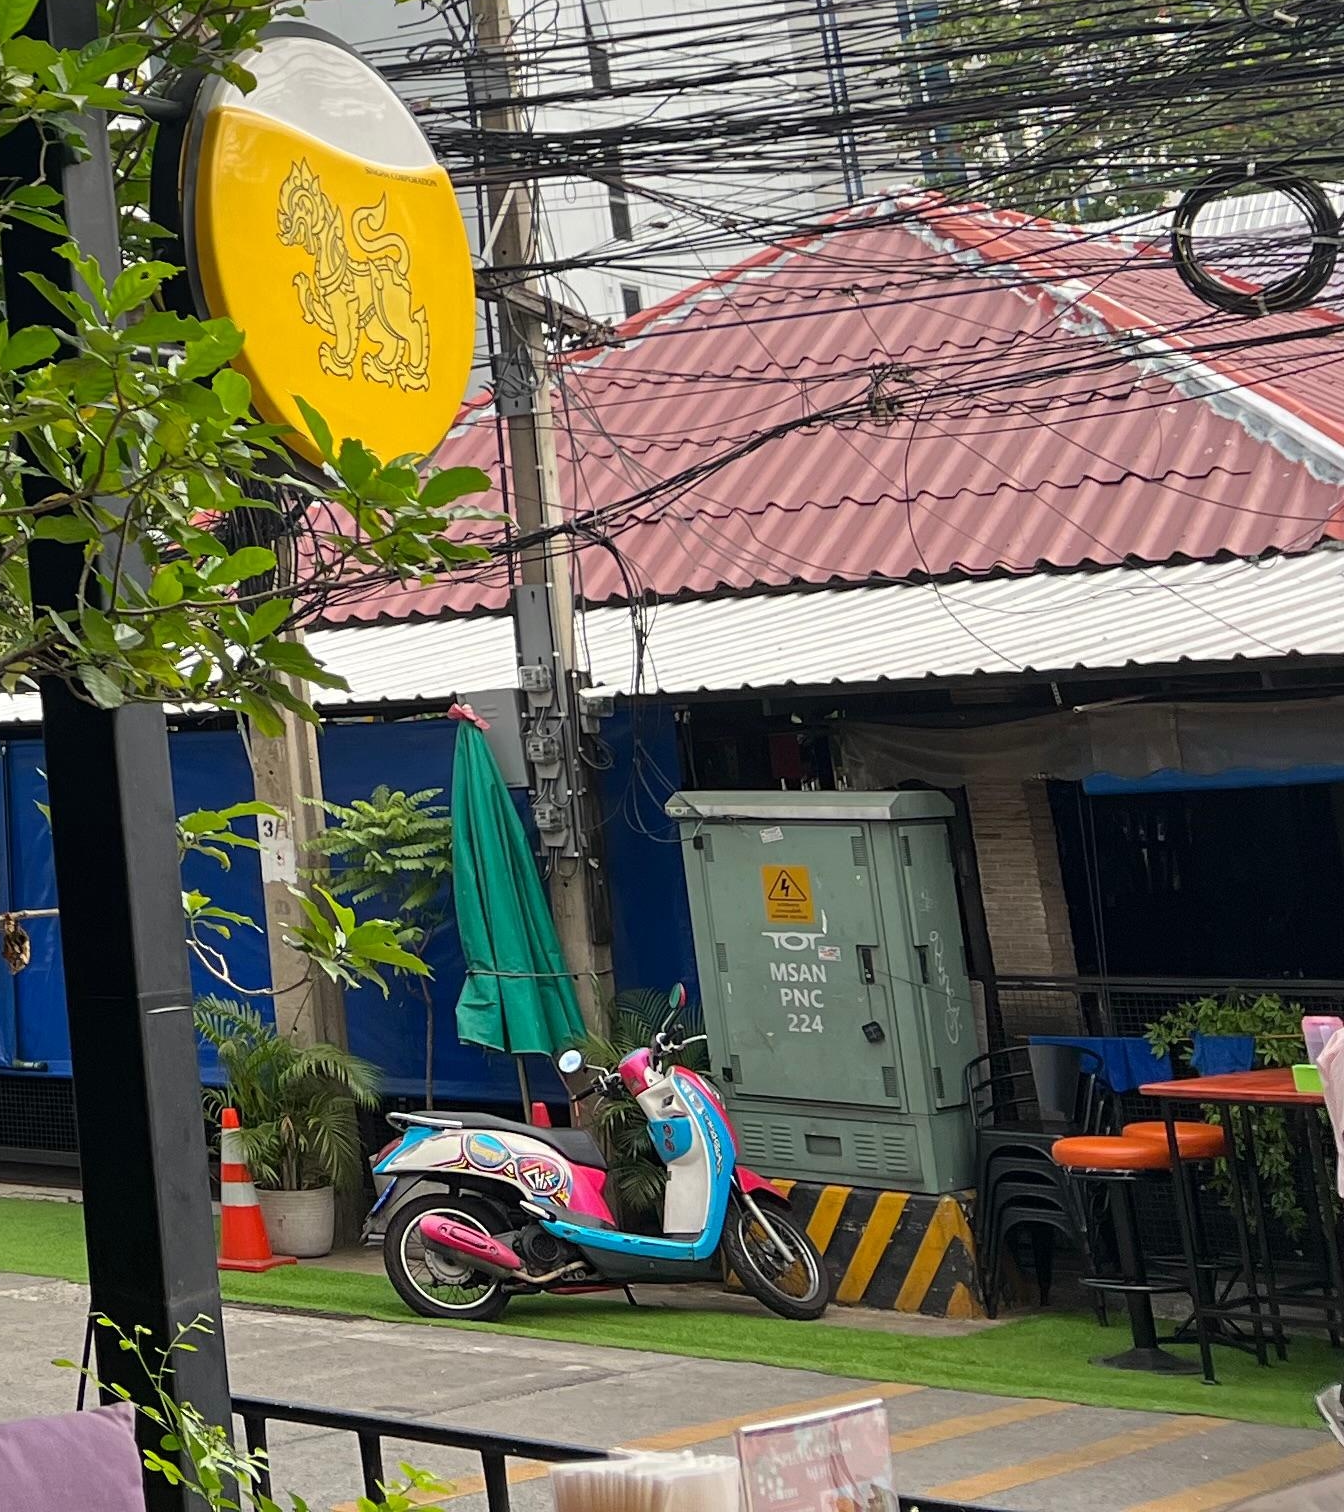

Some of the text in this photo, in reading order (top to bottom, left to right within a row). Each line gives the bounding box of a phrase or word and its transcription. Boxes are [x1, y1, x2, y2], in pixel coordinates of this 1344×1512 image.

[761, 931, 826, 952] TOT
[769, 962, 827, 983] MSAN
[780, 988, 824, 1009] PNC
[787, 1013, 824, 1034] 224
